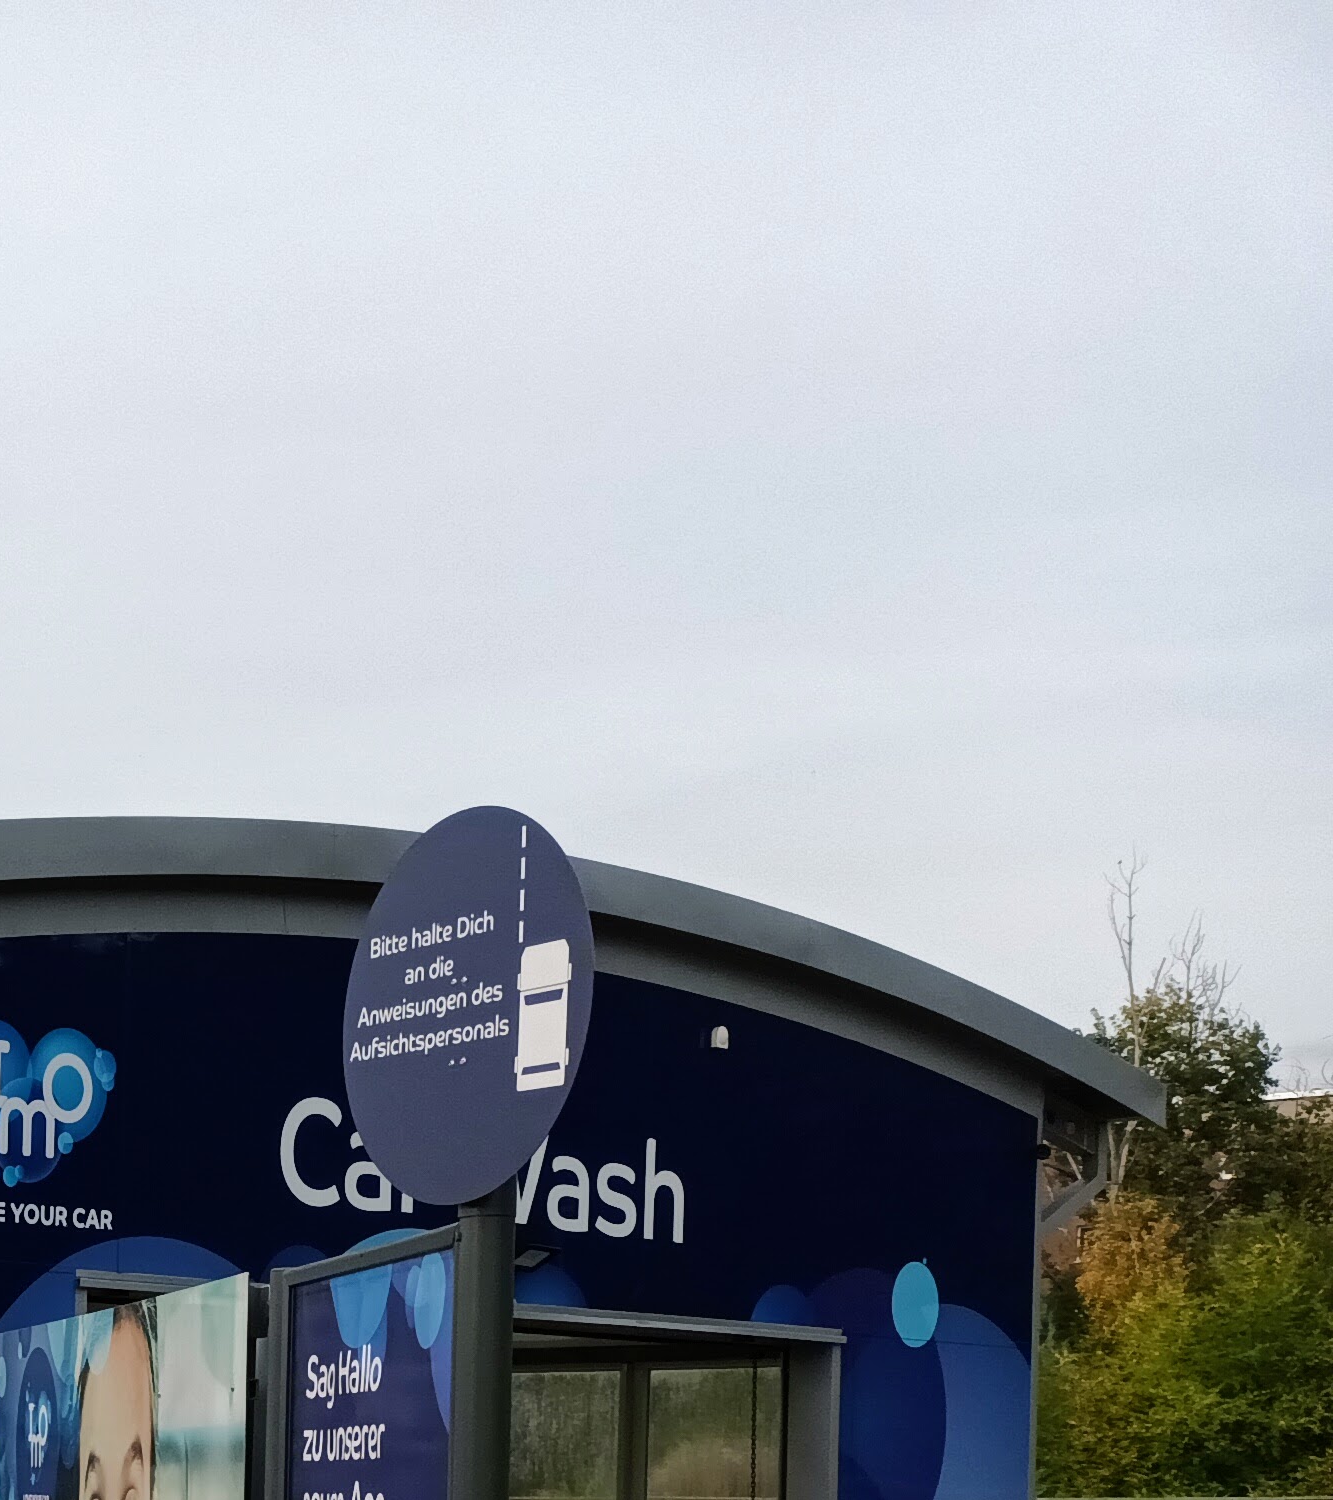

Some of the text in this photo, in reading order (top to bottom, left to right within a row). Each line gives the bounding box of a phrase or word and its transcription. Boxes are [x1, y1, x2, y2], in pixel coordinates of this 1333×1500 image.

[370, 910, 494, 959] Bitte halte Dich
[404, 956, 454, 985] an die
[357, 982, 503, 1029] Anweisungen des
[349, 1014, 510, 1063] Aufsichtspersonals
[280, 1097, 413, 1214] Ca
[10, 1202, 68, 1227] YOUR
[72, 1207, 113, 1230] CAR
[305, 1343, 383, 1409] Sag Hallo
[302, 1423, 386, 1462] zu unserer
